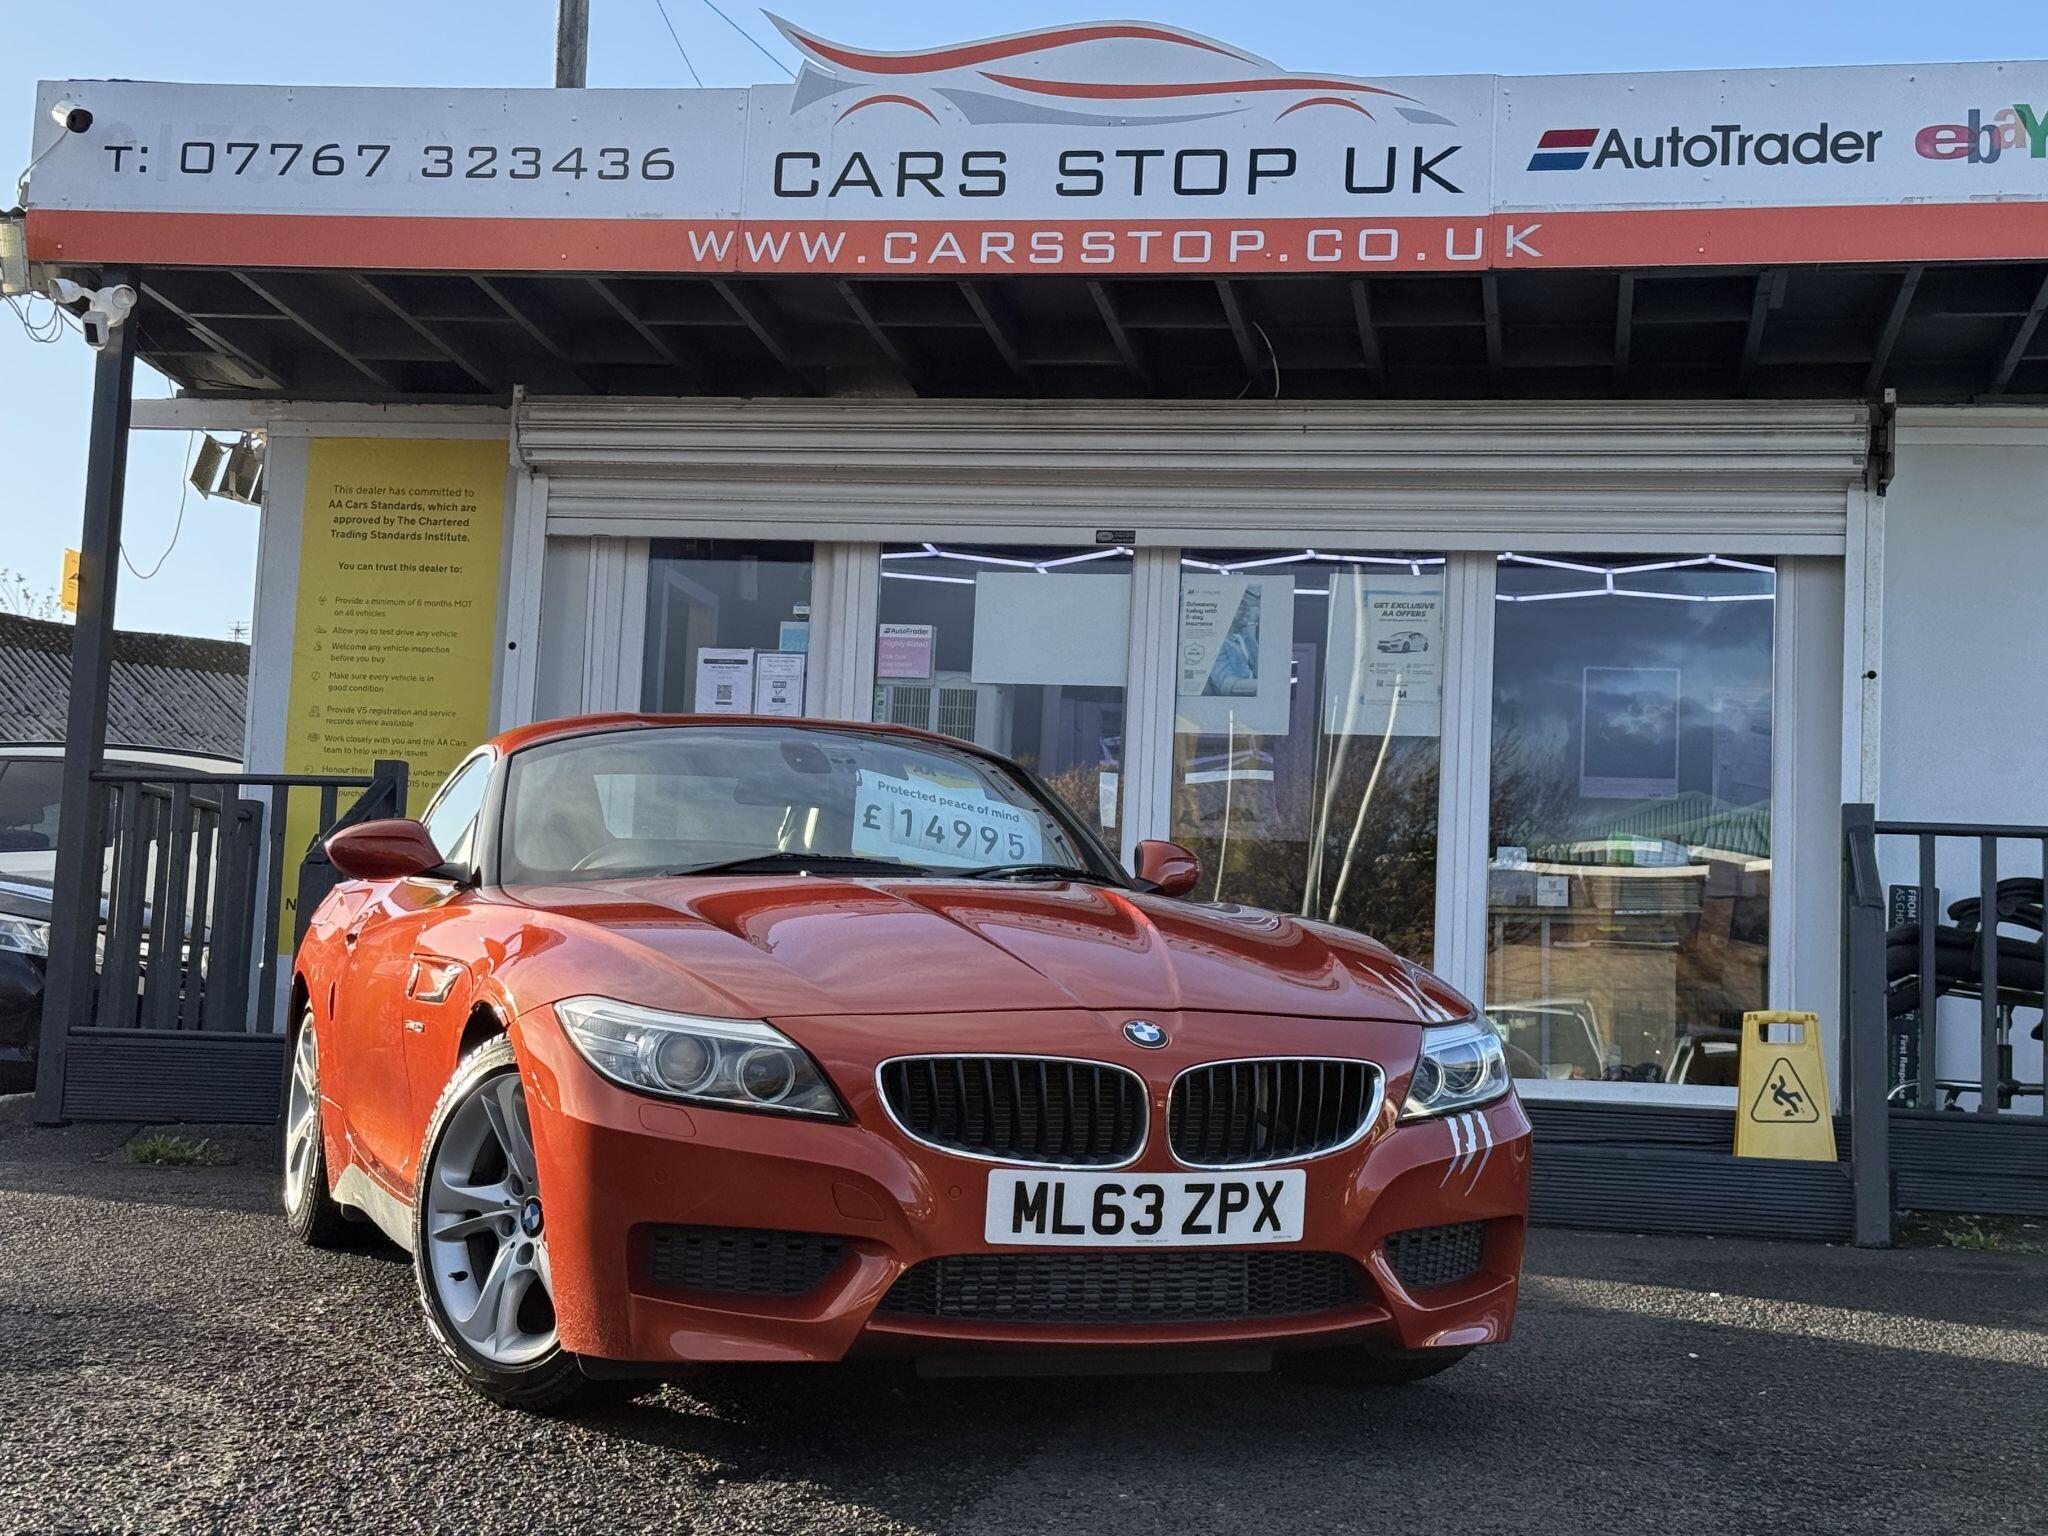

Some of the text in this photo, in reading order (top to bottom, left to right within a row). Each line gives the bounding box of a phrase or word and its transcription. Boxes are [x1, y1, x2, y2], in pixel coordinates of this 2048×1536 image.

[1593, 121, 1883, 170] AutoTrader
[104, 141, 676, 181] T: 07767 323436
[774, 145, 1465, 198] CARS STOP UK
[687, 223, 1543, 264] WWW.CARSSTOP.CO.UK
[334, 485, 475, 498] This dealer has committed to
[328, 500, 477, 513] AA Cars Standards, which are
[333, 515, 470, 527] approved by The Chartered
[330, 529, 471, 542] Trading Standards Institute.
[338, 561, 355, 571] You
[375, 563, 397, 572] trust
[399, 563, 417, 572] this
[418, 564, 448, 573] dealer
[450, 565, 463, 574] to:
[335, 596, 364, 606] Provide
[371, 598, 406, 607] minimum
[407, 599, 416, 607] of
[423, 600, 453, 609] months
[454, 600, 473, 609] MOT
[1390, 602, 1436, 610] EXCLUSIVE
[345, 609, 355, 617] all
[355, 609, 386, 618] vehicles
[1395, 610, 1427, 618] OFFERS
[332, 626, 458, 639] Allow you to test drive any vehicle
[331, 642, 450, 655] Welcome any vehicle inspection
[330, 654, 386, 665] before you buy
[329, 671, 350, 681] Make
[369, 674, 390, 683] every
[391, 674, 418, 682] vehicle
[418, 675, 425, 683] is
[426, 675, 434, 683] in
[328, 684, 384, 694] good condition
[327, 705, 456, 718] Provide V5 registration and service
[326, 718, 414, 728] records where available
[324, 734, 467, 747] Work closely with you and the AA Cars
[323, 746, 428, 758] team to help with any issues
[351, 766, 369, 774] their
[413, 769, 436, 777] under
[421, 781, 430, 789] to
[877, 780, 1020, 823] Protected peace of mind
[1907, 889, 1917, 918] FROM
[1900, 1034, 1909, 1054] First
[1011, 1179, 1284, 1235] ML63 ZPX
